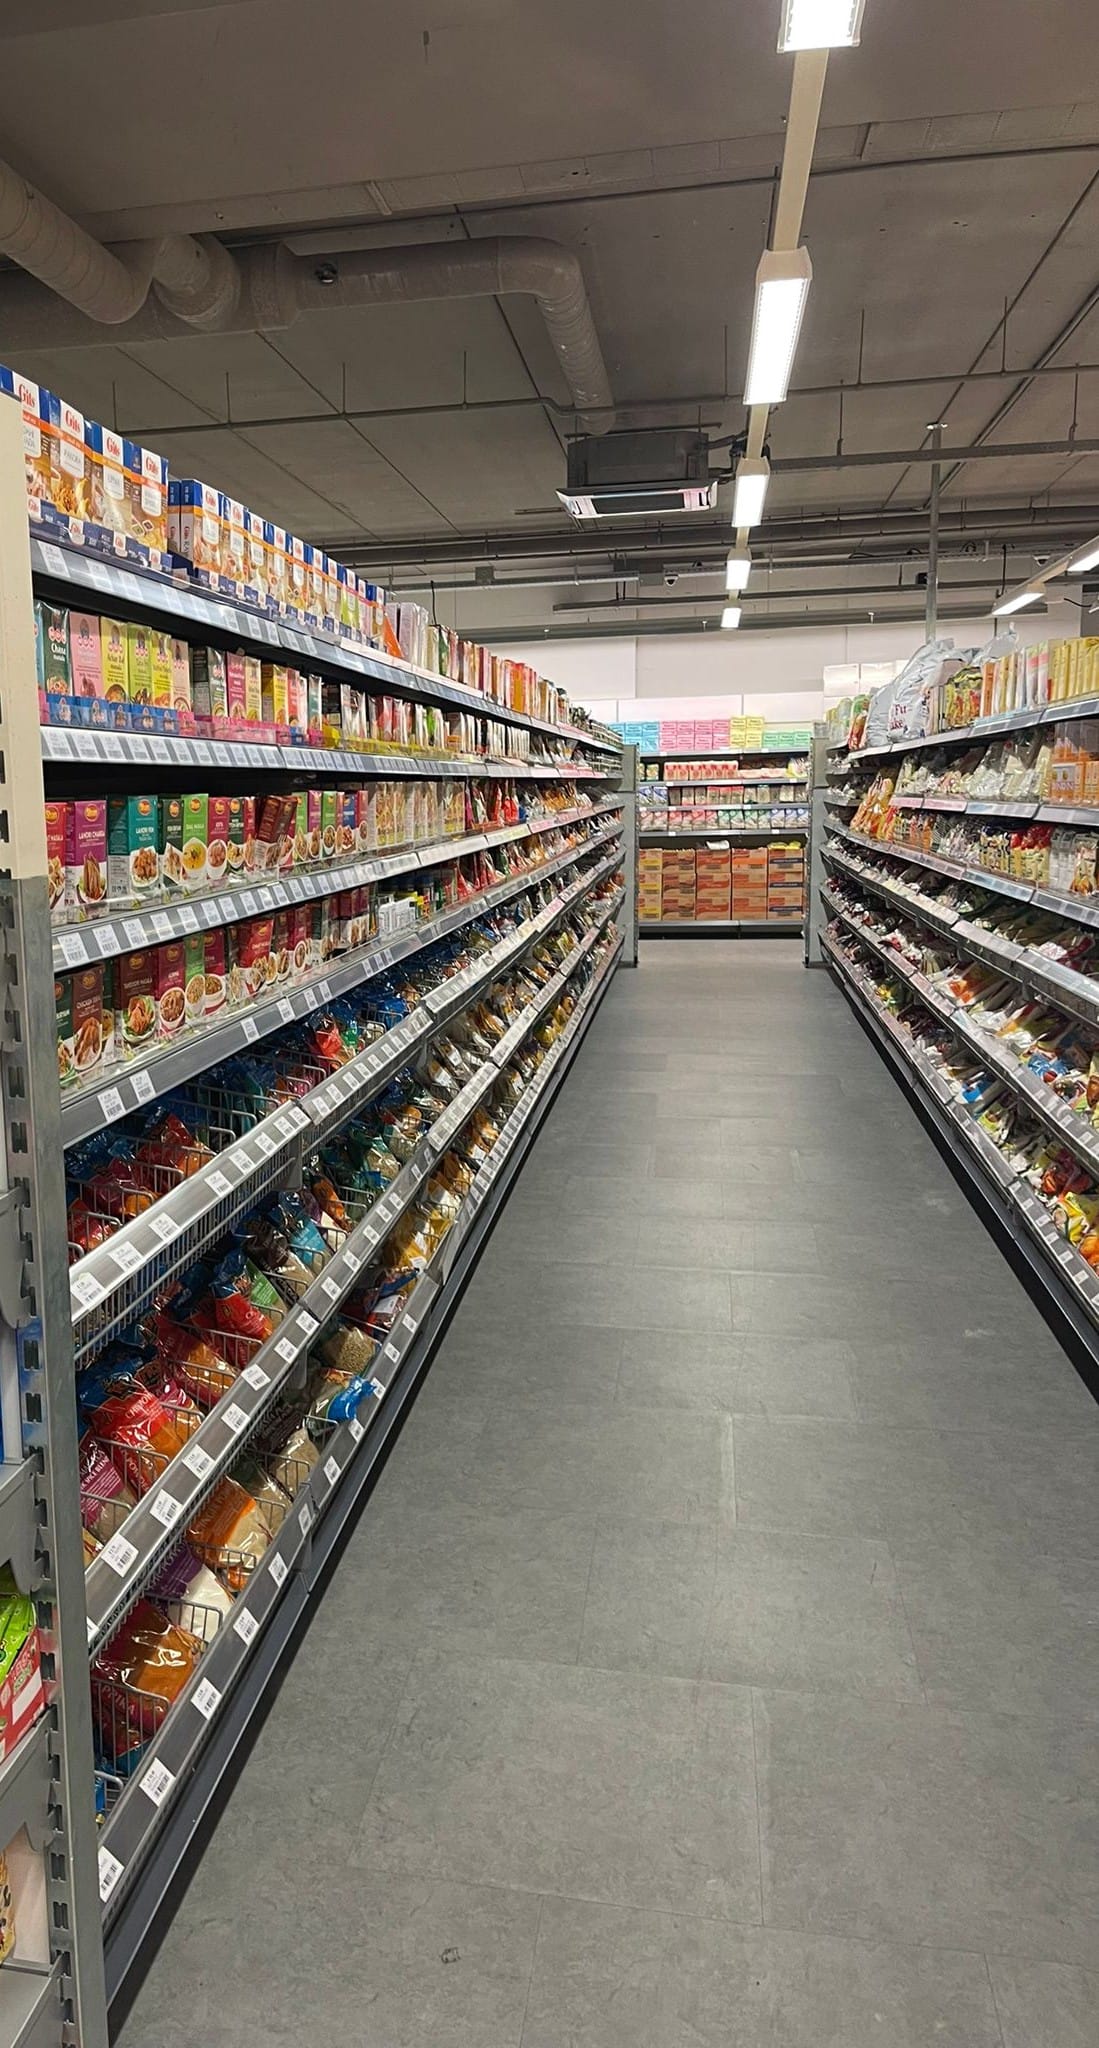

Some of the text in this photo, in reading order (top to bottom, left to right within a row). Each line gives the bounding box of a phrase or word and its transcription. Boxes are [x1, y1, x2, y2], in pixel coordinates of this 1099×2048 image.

[18, 383, 36, 408] Gits
[65, 409, 81, 434] Gits
[106, 436, 121, 458] Gits
[145, 455, 159, 476] Gits
